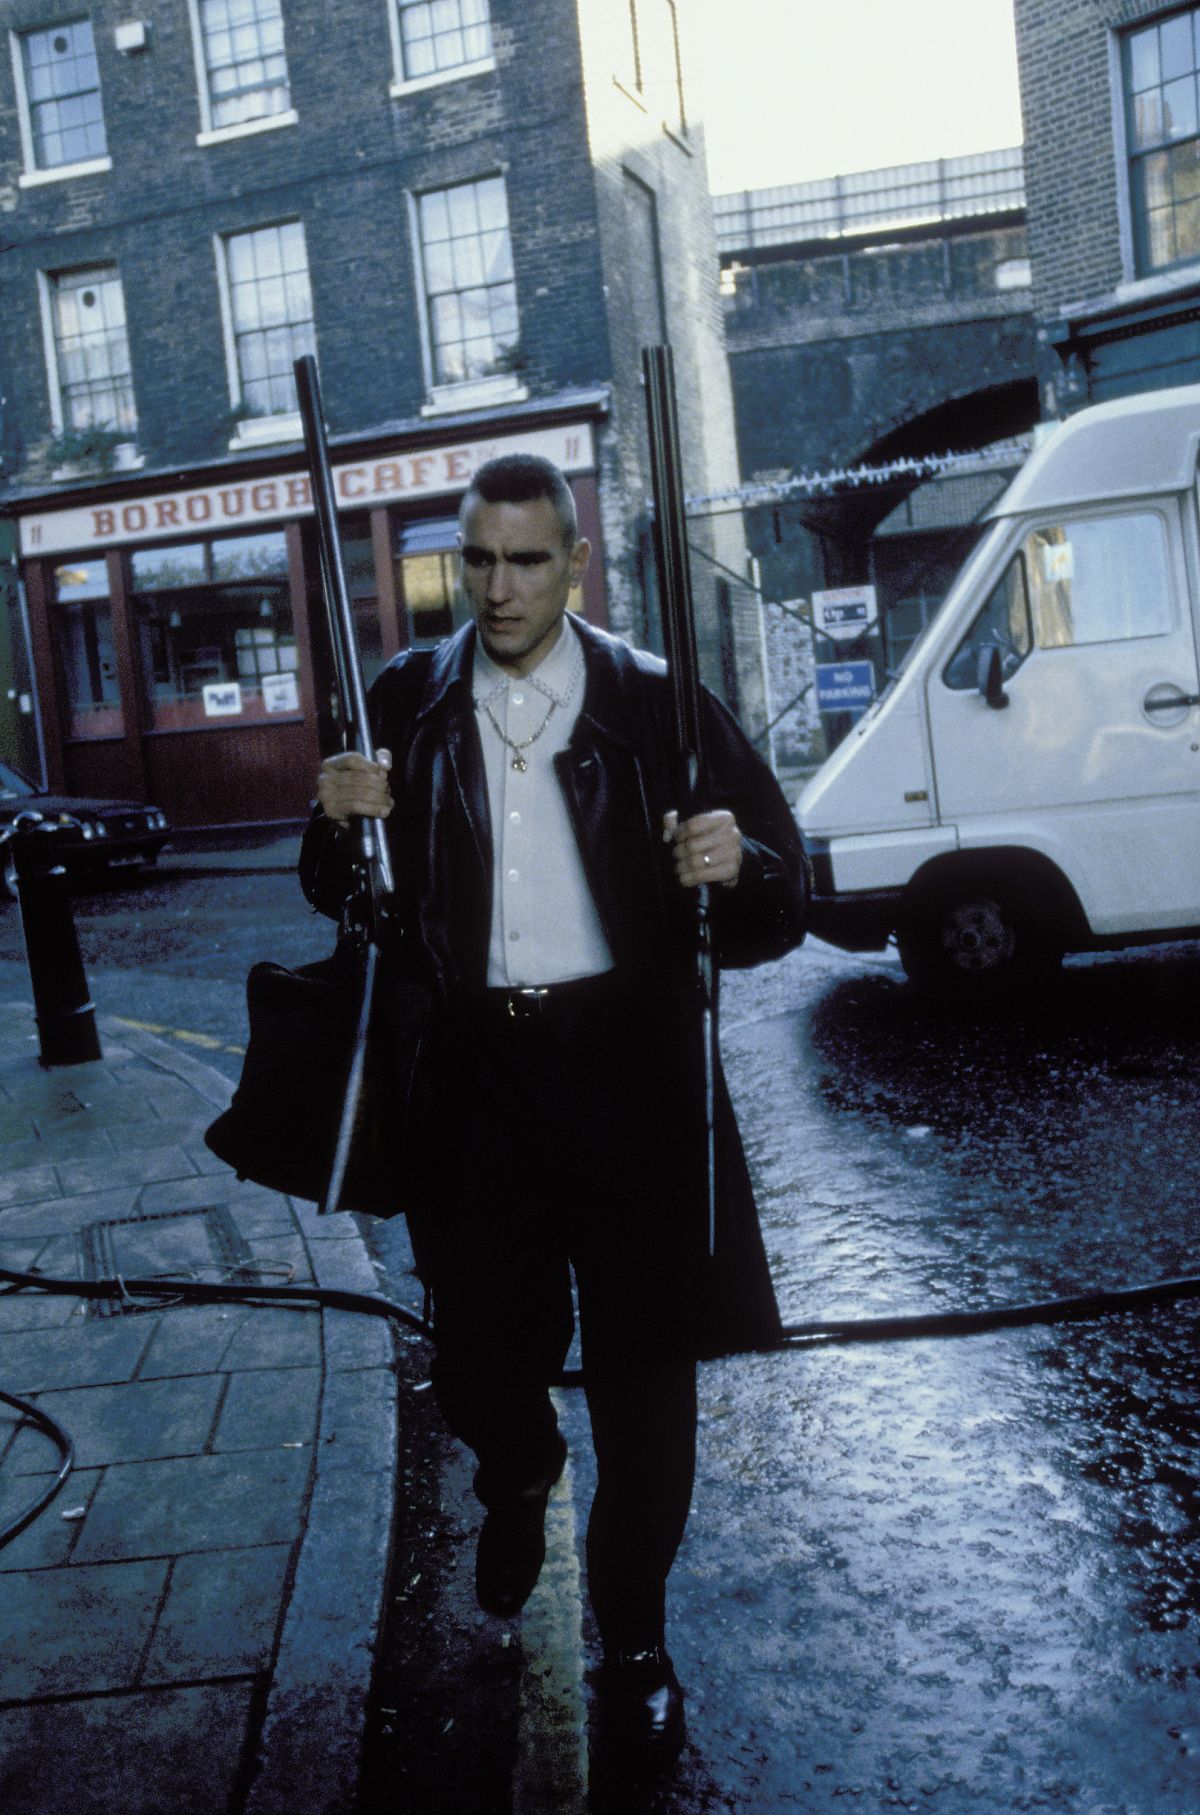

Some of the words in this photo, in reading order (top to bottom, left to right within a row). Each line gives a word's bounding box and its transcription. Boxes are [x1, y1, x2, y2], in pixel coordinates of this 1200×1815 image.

[92, 477, 313, 538] BOROUGH
[338, 449, 471, 498] CAFE
[833, 671, 853, 682] NO
[819, 685, 871, 700] PARKING
